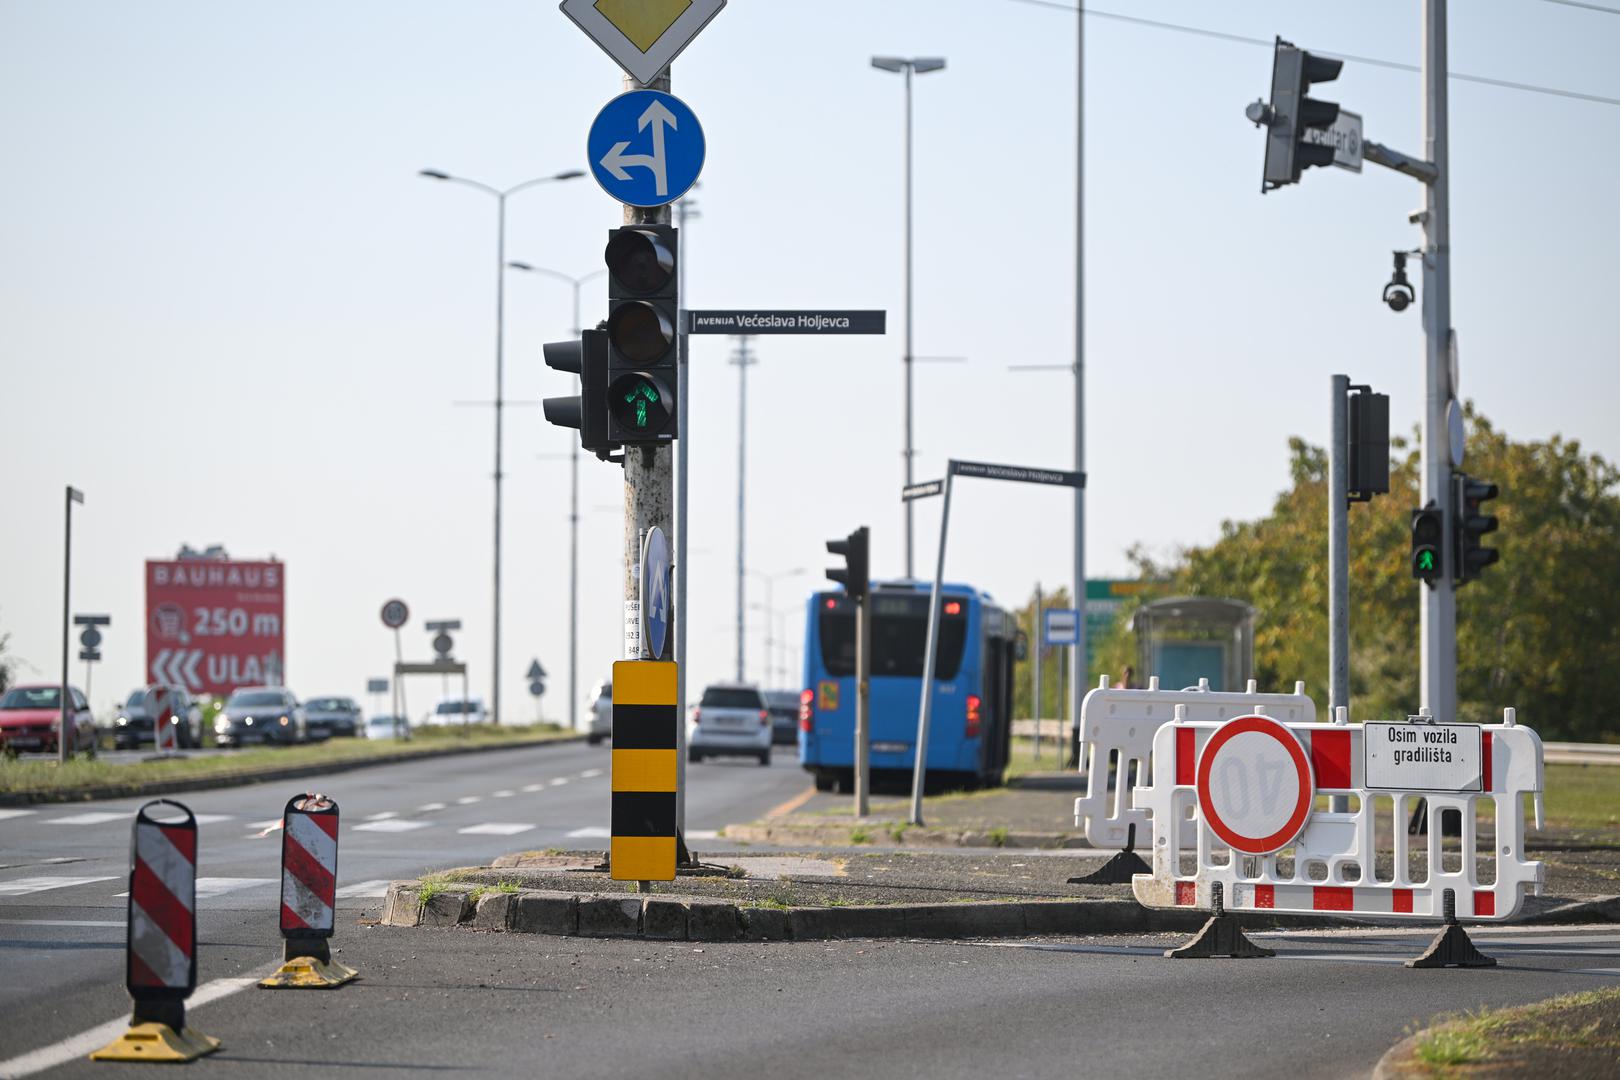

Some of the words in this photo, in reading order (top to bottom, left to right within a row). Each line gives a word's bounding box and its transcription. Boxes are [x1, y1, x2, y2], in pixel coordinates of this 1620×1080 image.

[697, 317, 735, 325] AVENIJA
[736, 313, 796, 328] Većeslava
[798, 314, 850, 330] Holjevca
[153, 565, 278, 587] BAUHAUS
[194, 606, 248, 637] 250
[252, 612, 279, 637] m
[1388, 727, 1417, 744] Osim
[1423, 728, 1457, 745] vozila
[1394, 745, 1453, 765] gradilišta
